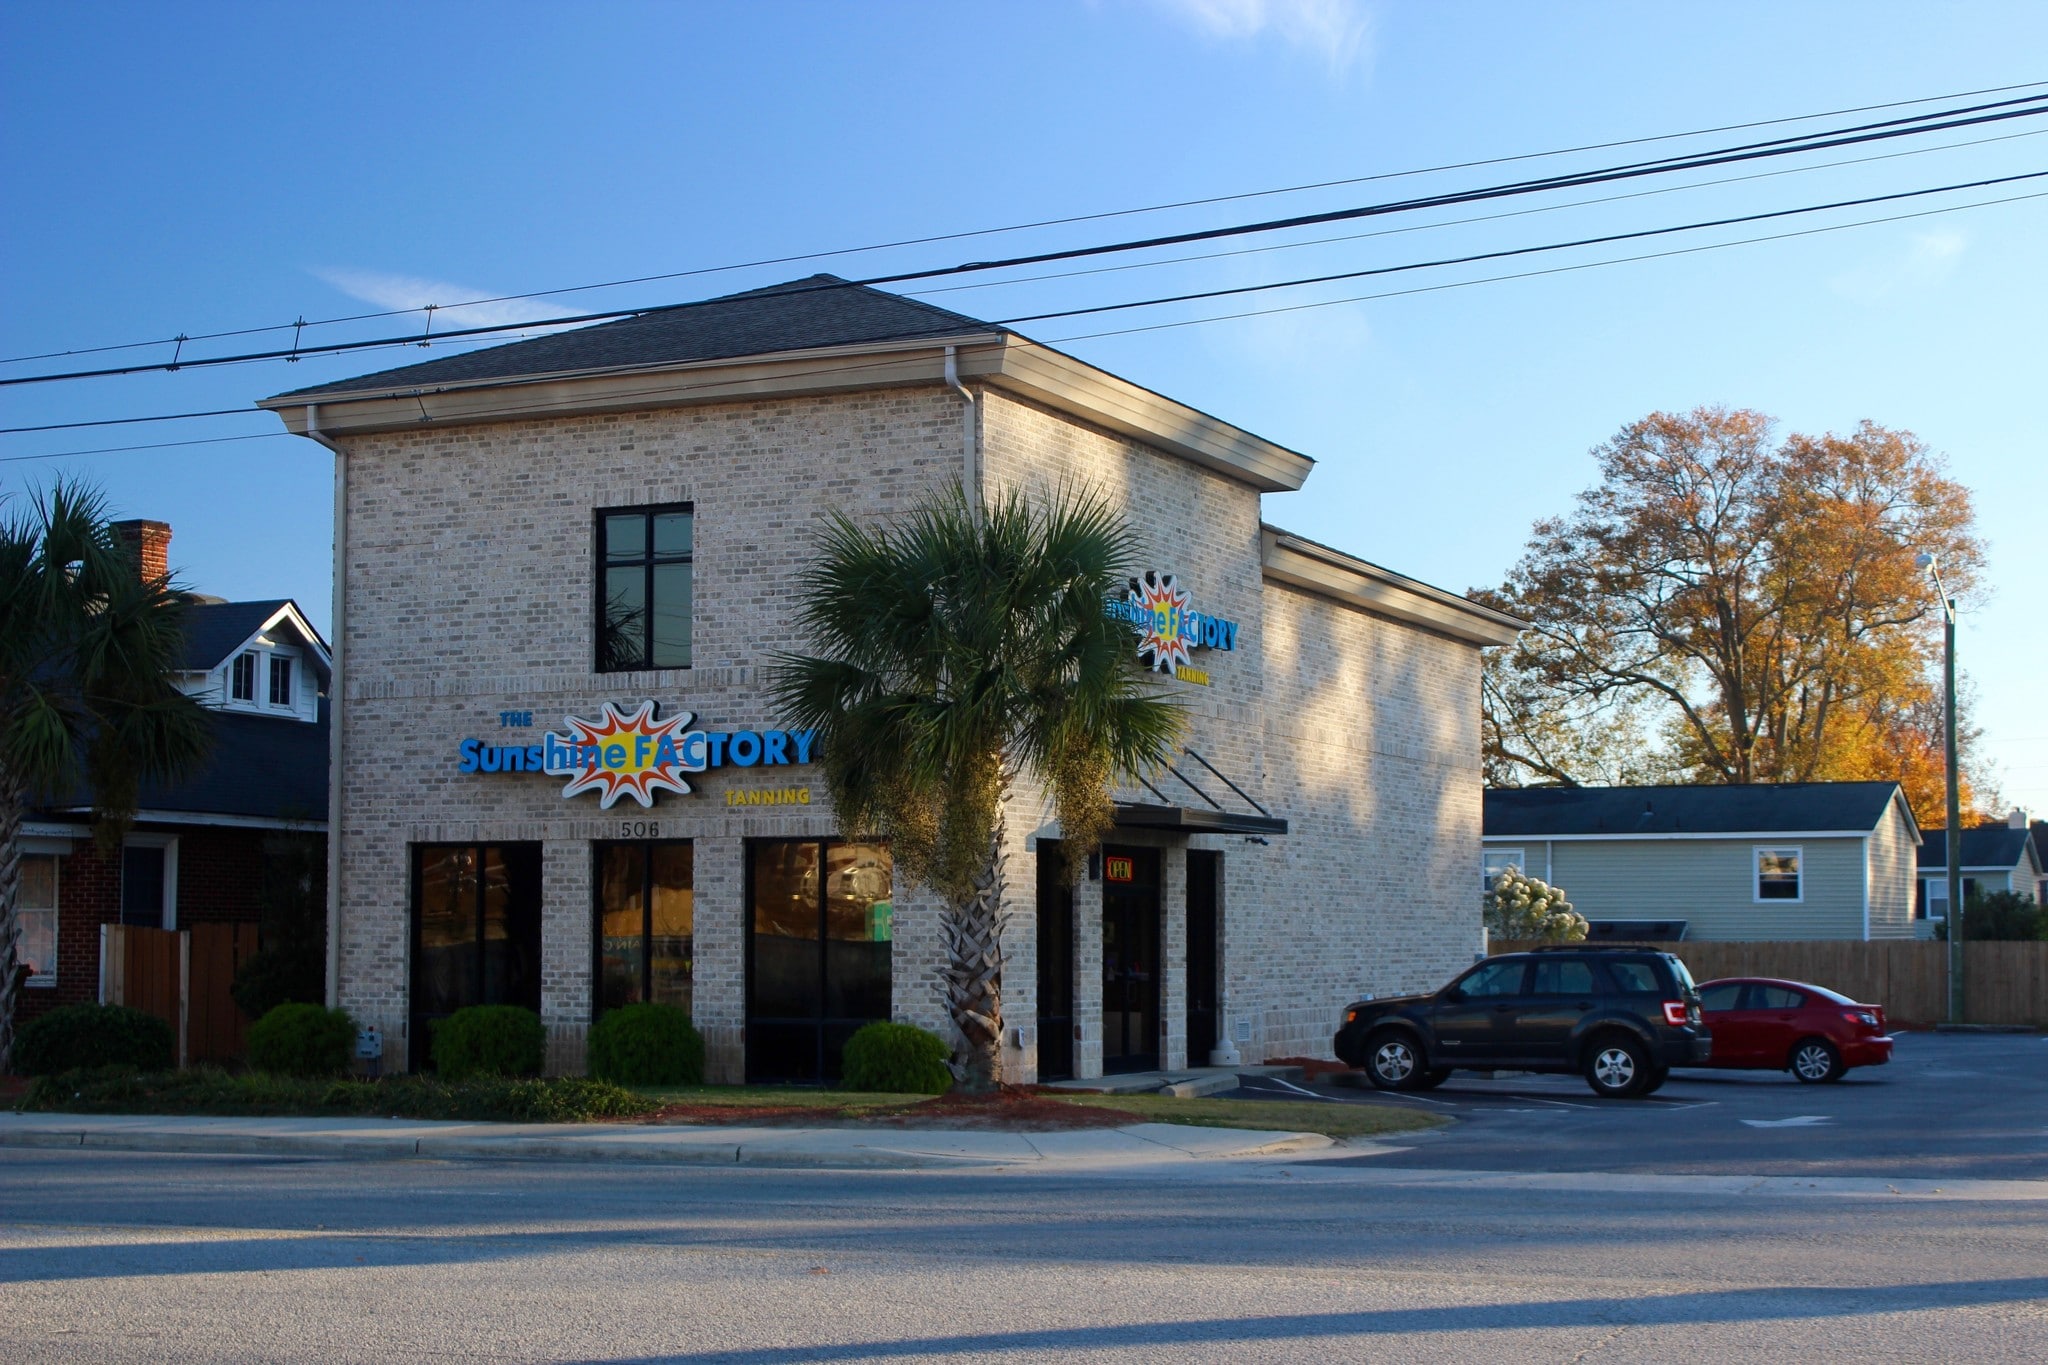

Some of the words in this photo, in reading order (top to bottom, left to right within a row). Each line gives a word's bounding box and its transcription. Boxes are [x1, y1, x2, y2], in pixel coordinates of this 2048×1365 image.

[1169, 606, 1239, 652] FACTORY
[1176, 666, 1210, 687] TANNING
[500, 711, 533, 728] THE
[458, 734, 626, 774] Sunshine
[634, 728, 815, 768] FACTORY
[724, 787, 810, 807] TANNING
[621, 821, 660, 838] 506
[1109, 860, 1130, 879] OPEN
